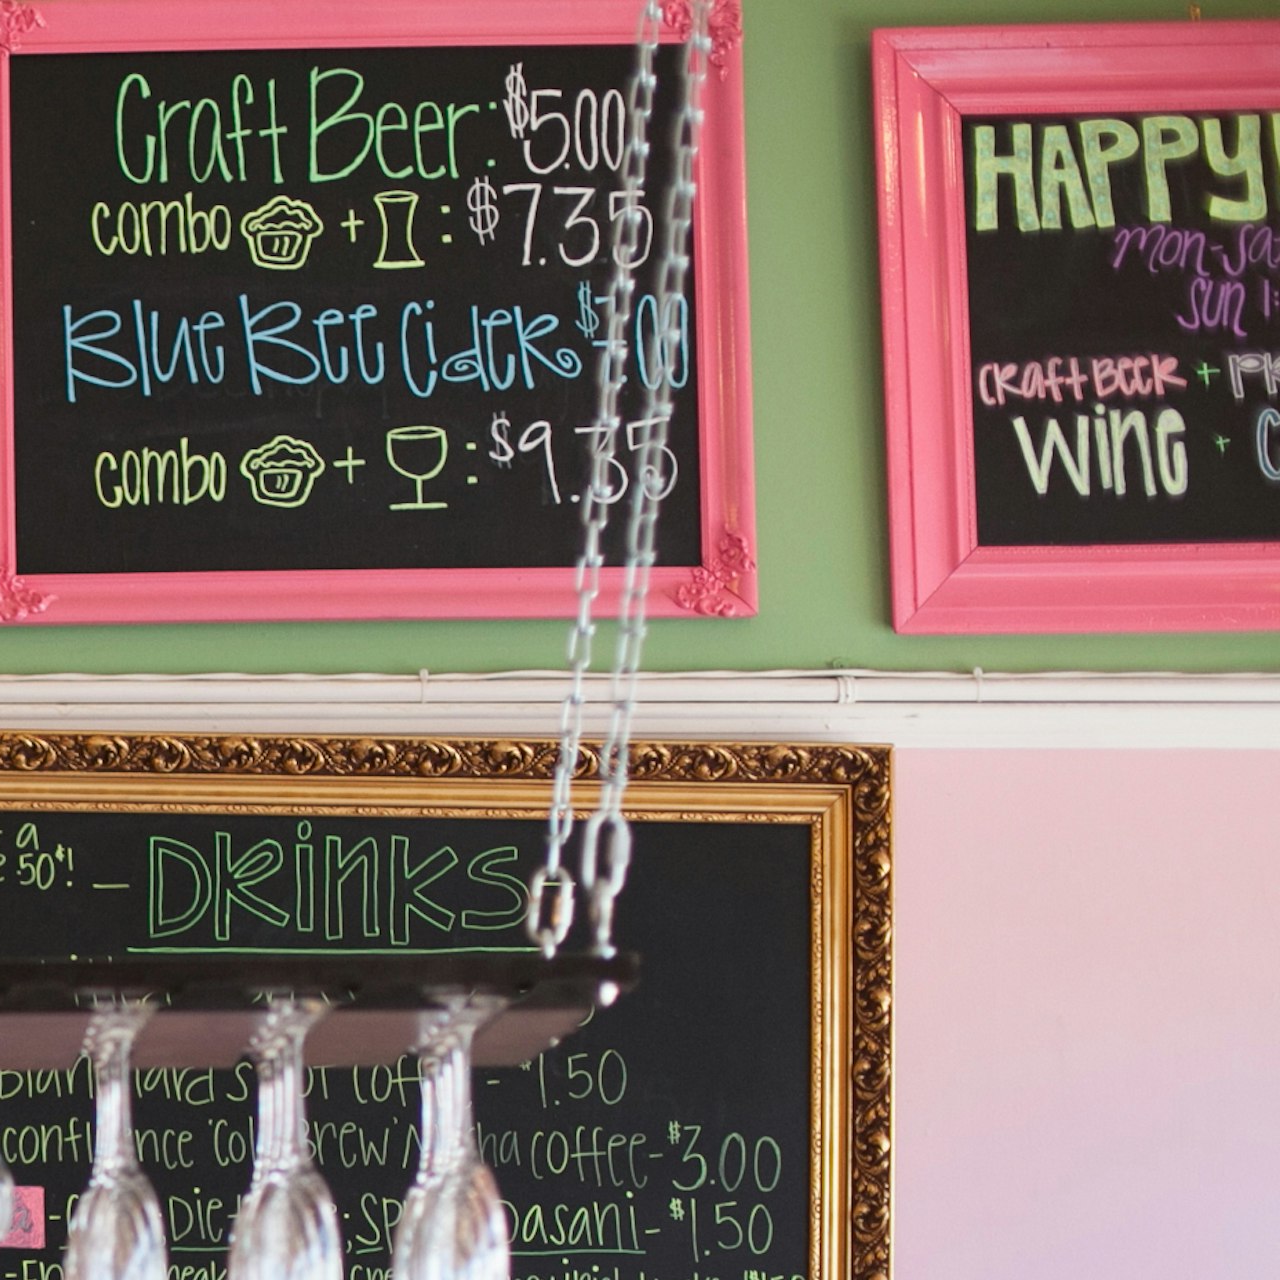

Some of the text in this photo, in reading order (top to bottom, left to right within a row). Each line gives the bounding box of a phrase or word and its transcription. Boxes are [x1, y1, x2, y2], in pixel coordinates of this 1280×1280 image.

[114, 72, 288, 185] Craft
[309, 65, 498, 183] Beer:
[91, 191, 232, 257] combo
[63, 298, 226, 403] Blue
[238, 293, 385, 395] Bee
[94, 437, 228, 509] combo
[15, 822, 40, 851] a
[530, 1125, 648, 1189] coffee
